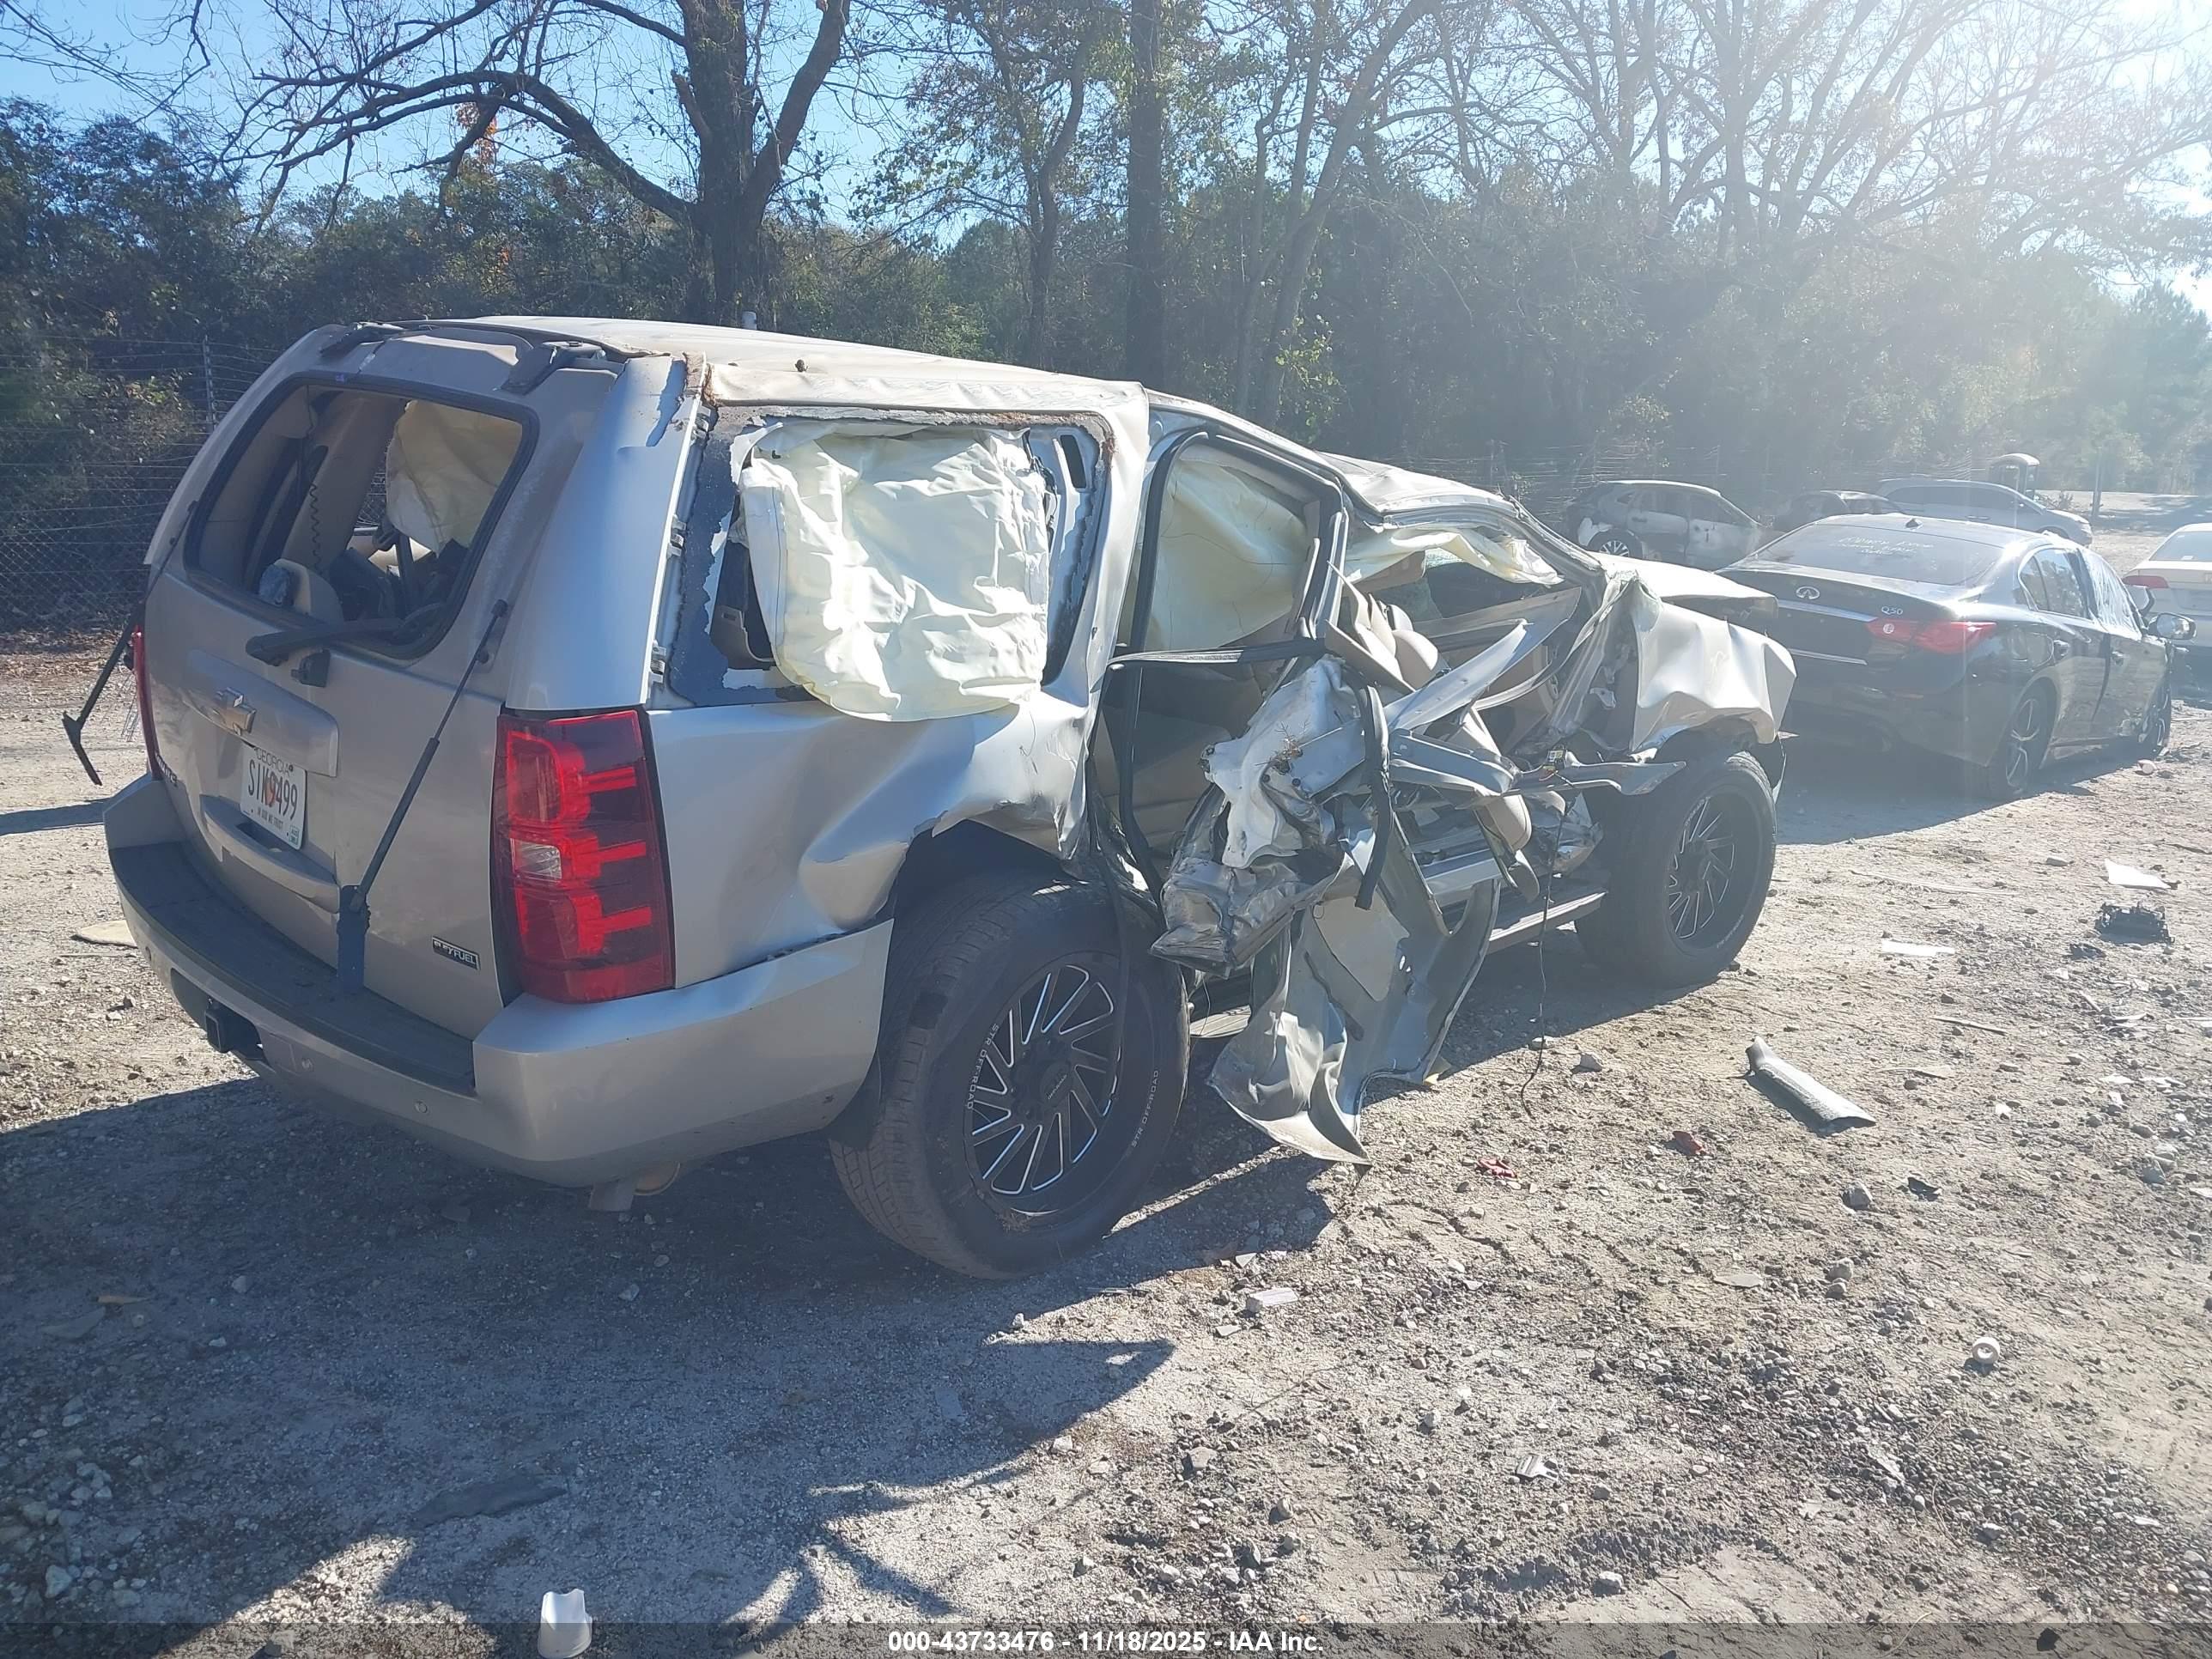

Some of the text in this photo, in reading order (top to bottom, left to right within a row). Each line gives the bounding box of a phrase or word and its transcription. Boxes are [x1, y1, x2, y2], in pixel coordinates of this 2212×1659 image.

[1881, 605, 1904, 616] Q50
[256, 746, 290, 777] GEORGIA
[967, 1023, 1000, 1109] STR OFF-ROAD
[1131, 1070, 1159, 1147] STR OFF-ROAD
